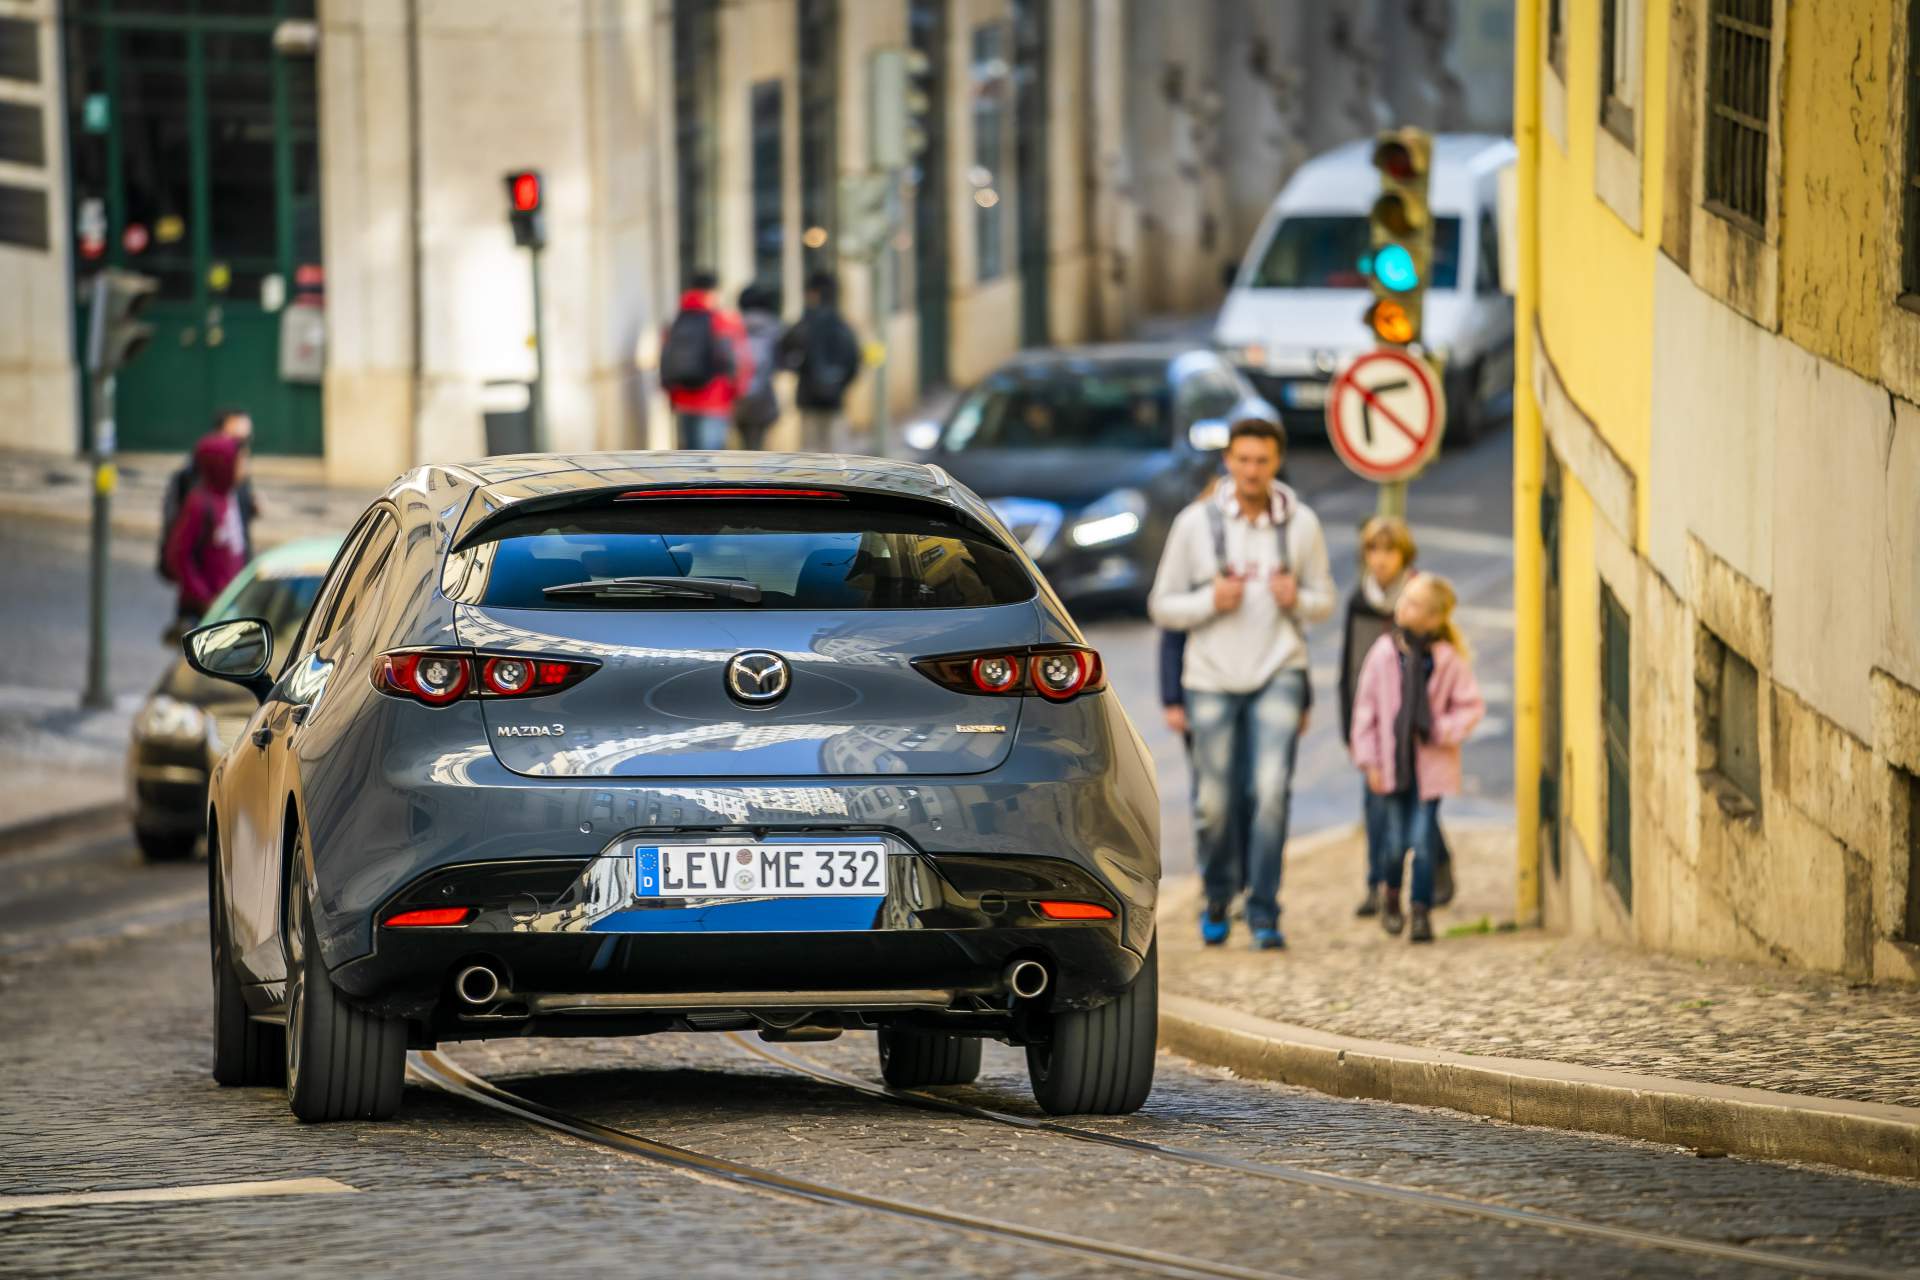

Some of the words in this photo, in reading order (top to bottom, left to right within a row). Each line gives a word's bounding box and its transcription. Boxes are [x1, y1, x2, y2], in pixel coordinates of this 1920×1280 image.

[643, 876, 653, 888] D
[662, 852, 730, 889] LEV
[760, 851, 804, 888] ME
[815, 850, 880, 888] 332
